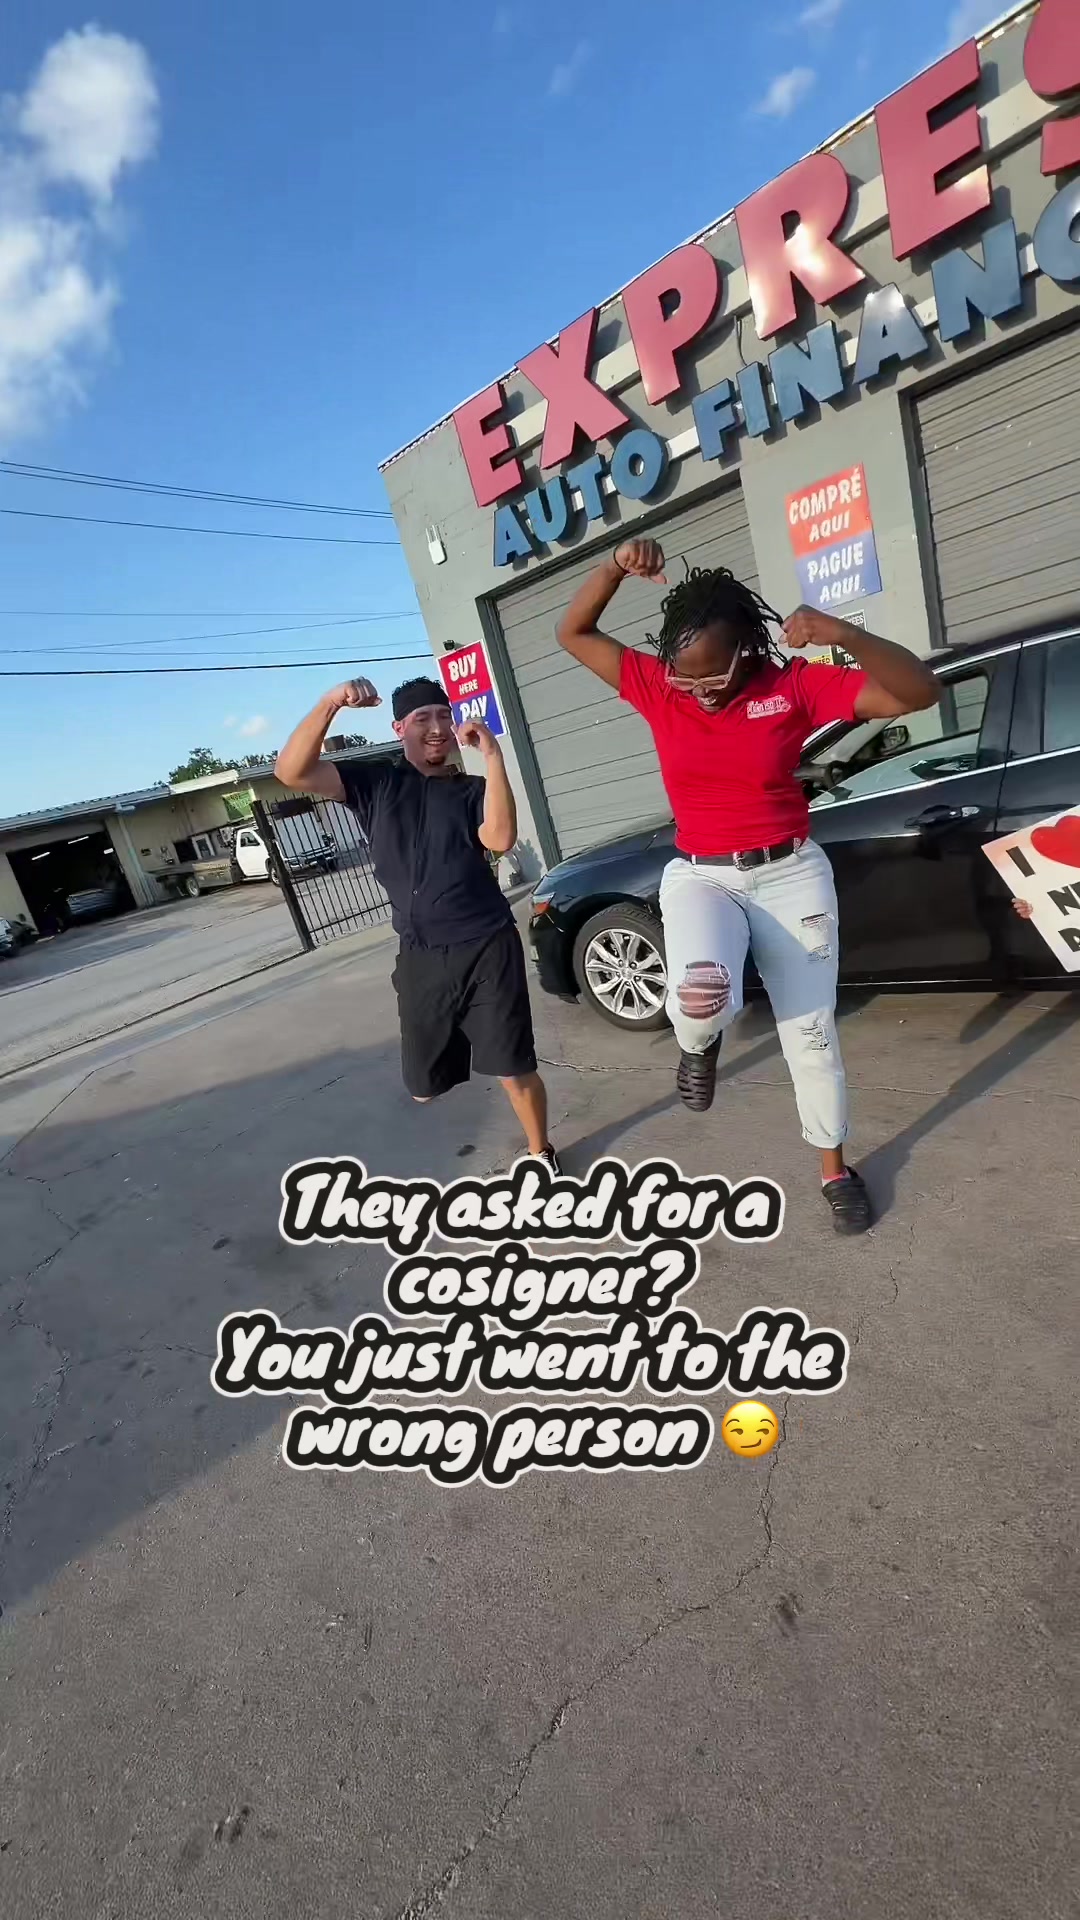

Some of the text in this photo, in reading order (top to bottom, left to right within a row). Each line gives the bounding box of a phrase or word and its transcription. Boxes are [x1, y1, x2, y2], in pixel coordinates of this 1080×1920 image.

[493, 428, 666, 568] AUTO
[788, 466, 863, 525] COMPRÉ
[808, 509, 850, 543] AQUI
[807, 541, 864, 584] PAGUE
[447, 652, 477, 682] BUY
[458, 679, 479, 696] HERE
[459, 695, 487, 722] PAY
[1006, 846, 1036, 878] I
